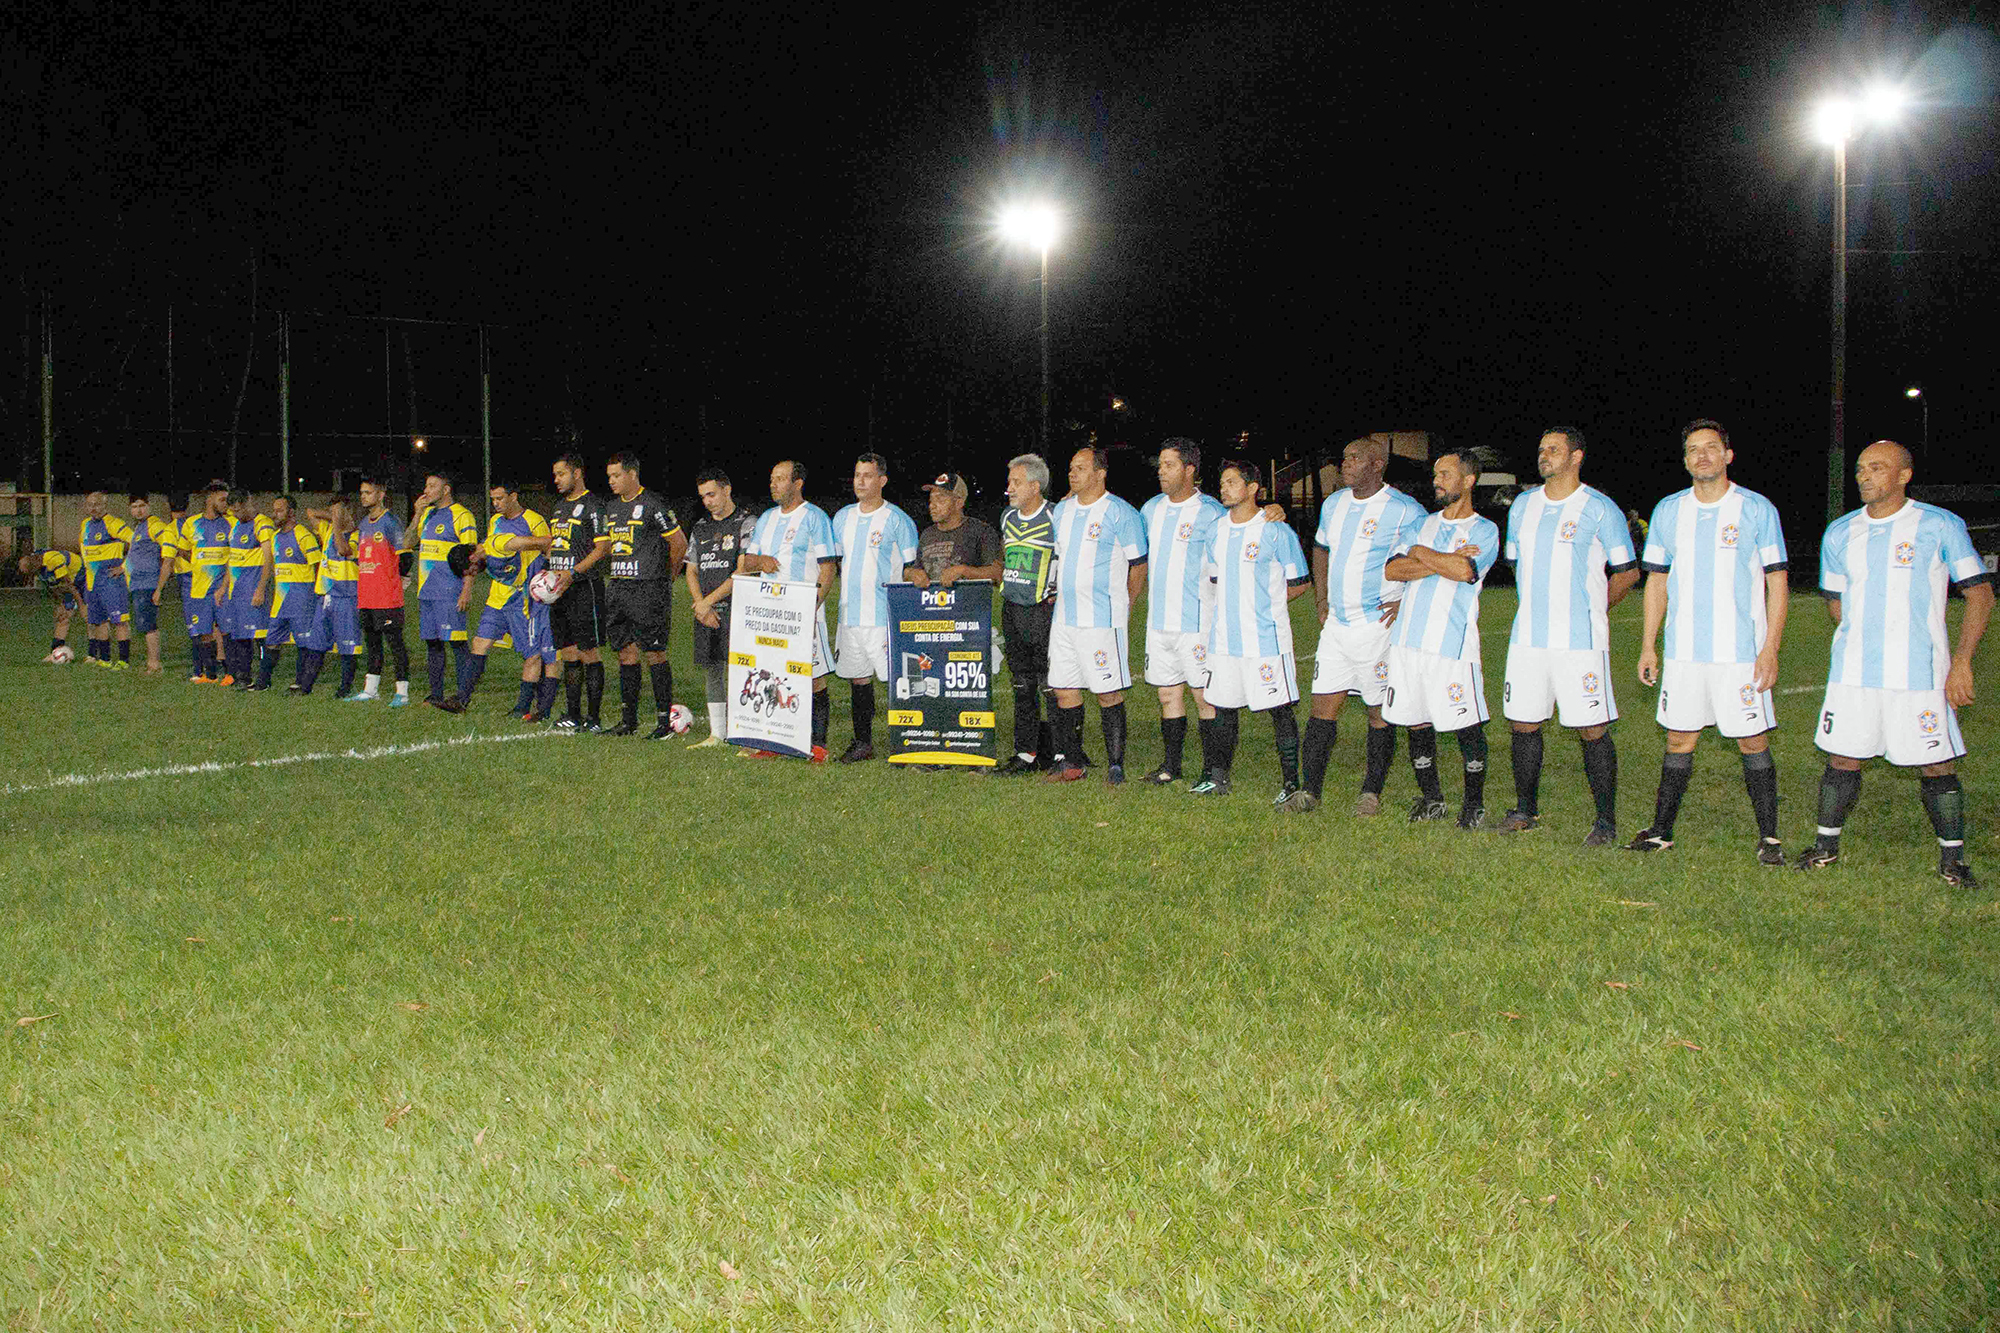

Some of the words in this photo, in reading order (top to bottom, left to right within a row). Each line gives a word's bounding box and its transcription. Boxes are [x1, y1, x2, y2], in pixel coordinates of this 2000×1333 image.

[700, 553, 716, 561] neo
[744, 605, 752, 616] SE
[784, 610, 797, 622] COM
[797, 611, 802, 622] O
[762, 621, 770, 632] DA
[770, 622, 801, 636] GASOLINA?
[901, 622, 917, 632] ADEUS
[955, 621, 967, 631] COM
[968, 621, 980, 631] SUA
[757, 636, 772, 646] NUNCA
[914, 633, 931, 642] CONTA
[932, 633, 940, 642] DE
[737, 656, 750, 667] 72X
[788, 664, 802, 674] 18X
[945, 661, 987, 689] 95%
[1504, 681, 1511, 702] 9
[898, 715, 914, 724] 72X
[964, 717, 981, 726] 18X
[1823, 710, 1834, 734] 5
